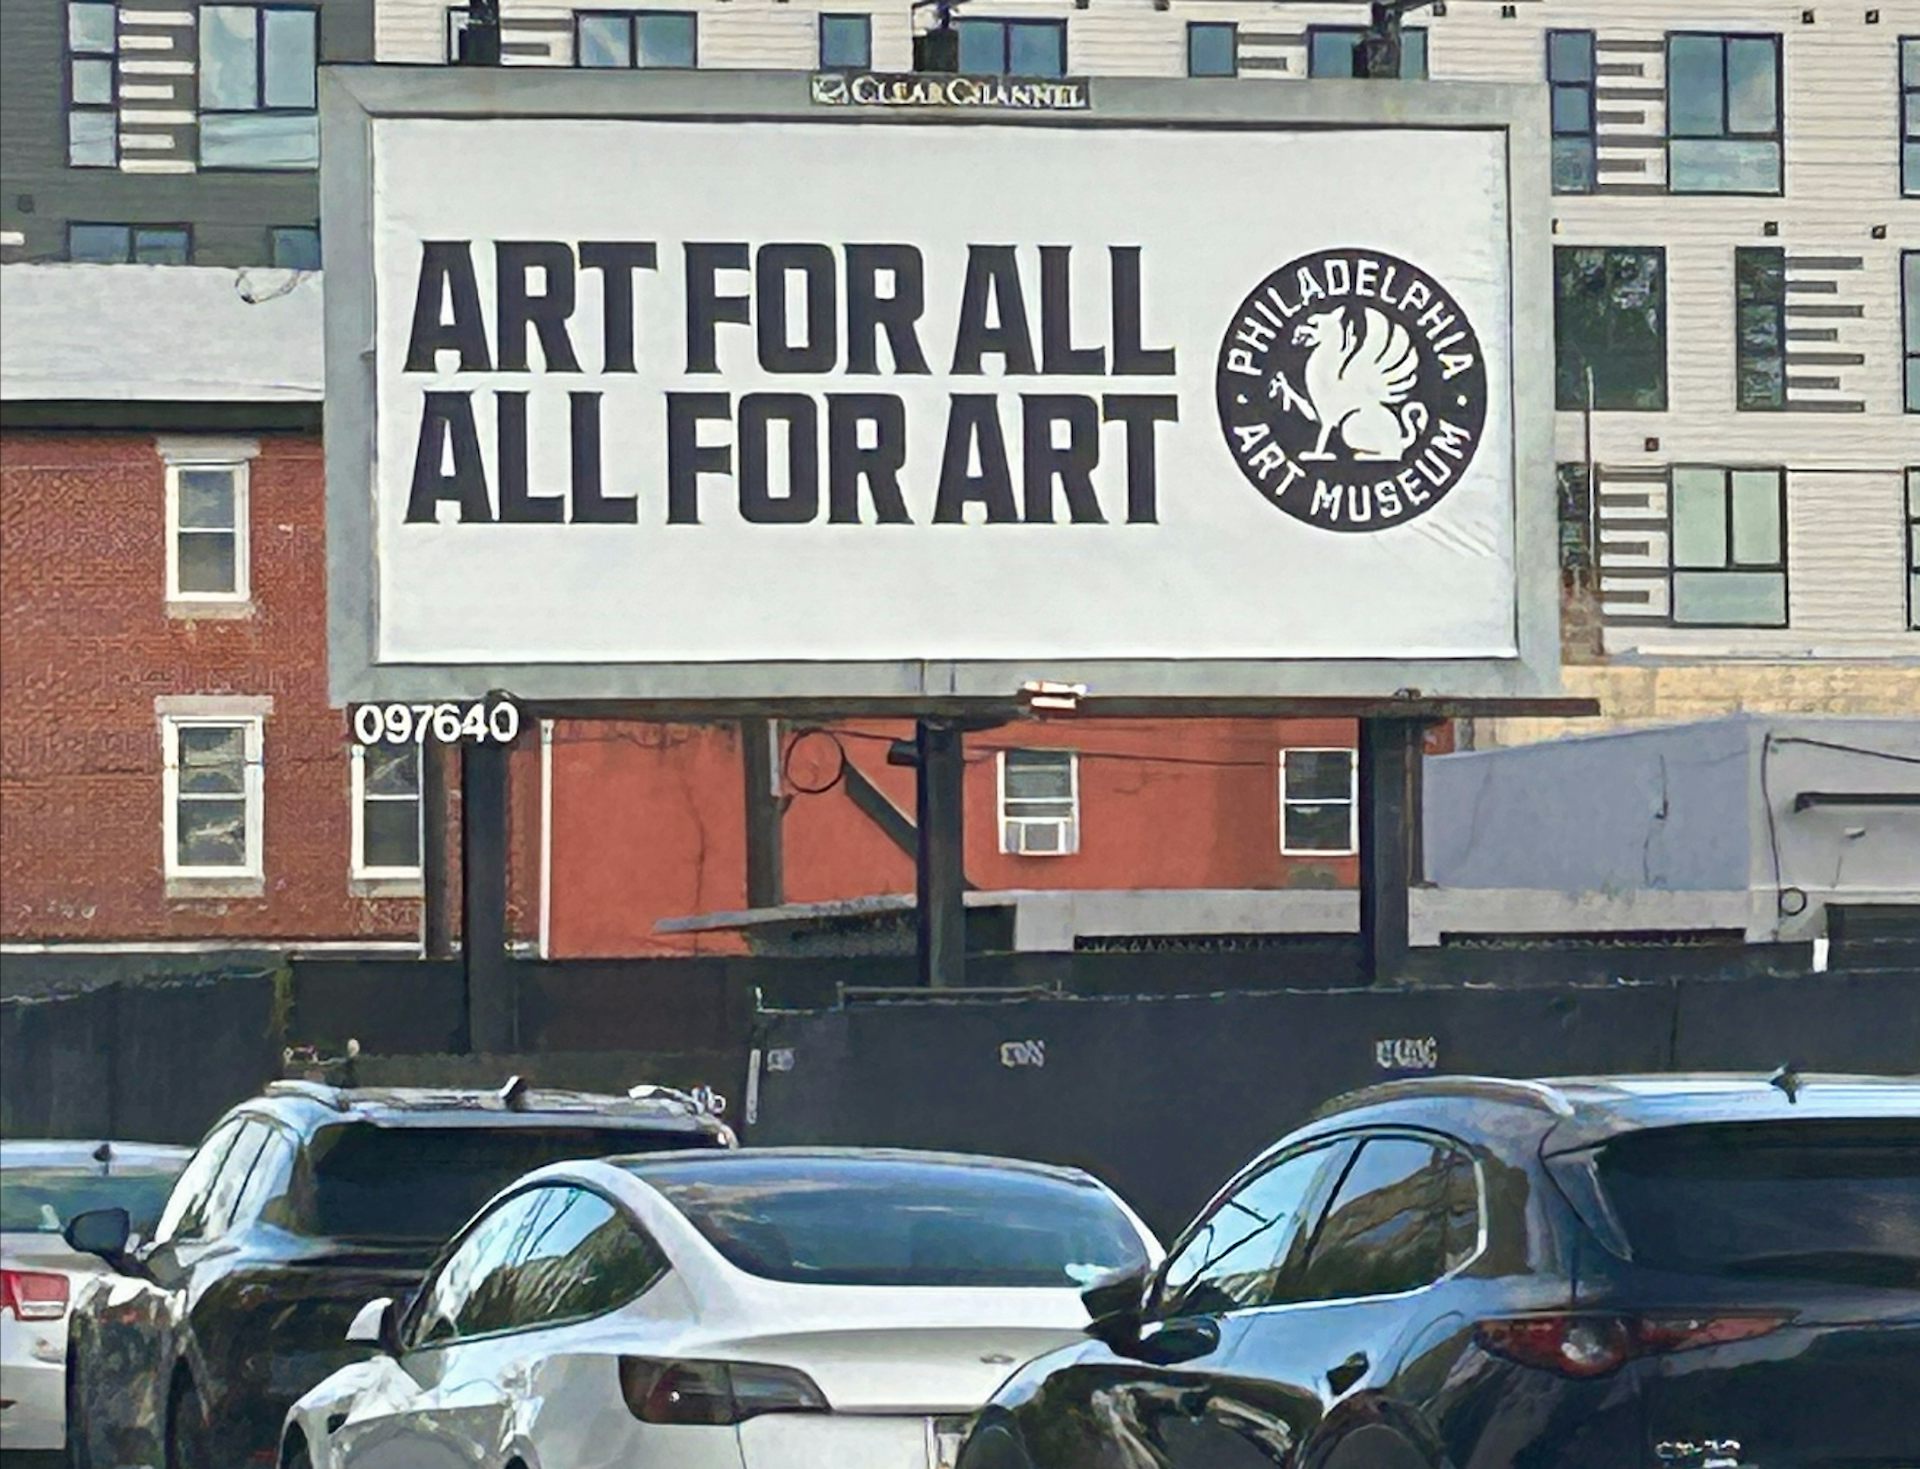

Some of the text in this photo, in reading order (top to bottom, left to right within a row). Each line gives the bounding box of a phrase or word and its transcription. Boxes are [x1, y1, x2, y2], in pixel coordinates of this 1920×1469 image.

[402, 240, 1176, 376] ART FOR ALL
[1226, 258, 1474, 380] PHILADELPHIA
[403, 390, 1179, 525] ALL FOR ART
[1233, 419, 1471, 522] ART MUSEUM
[354, 702, 519, 745] 097640
